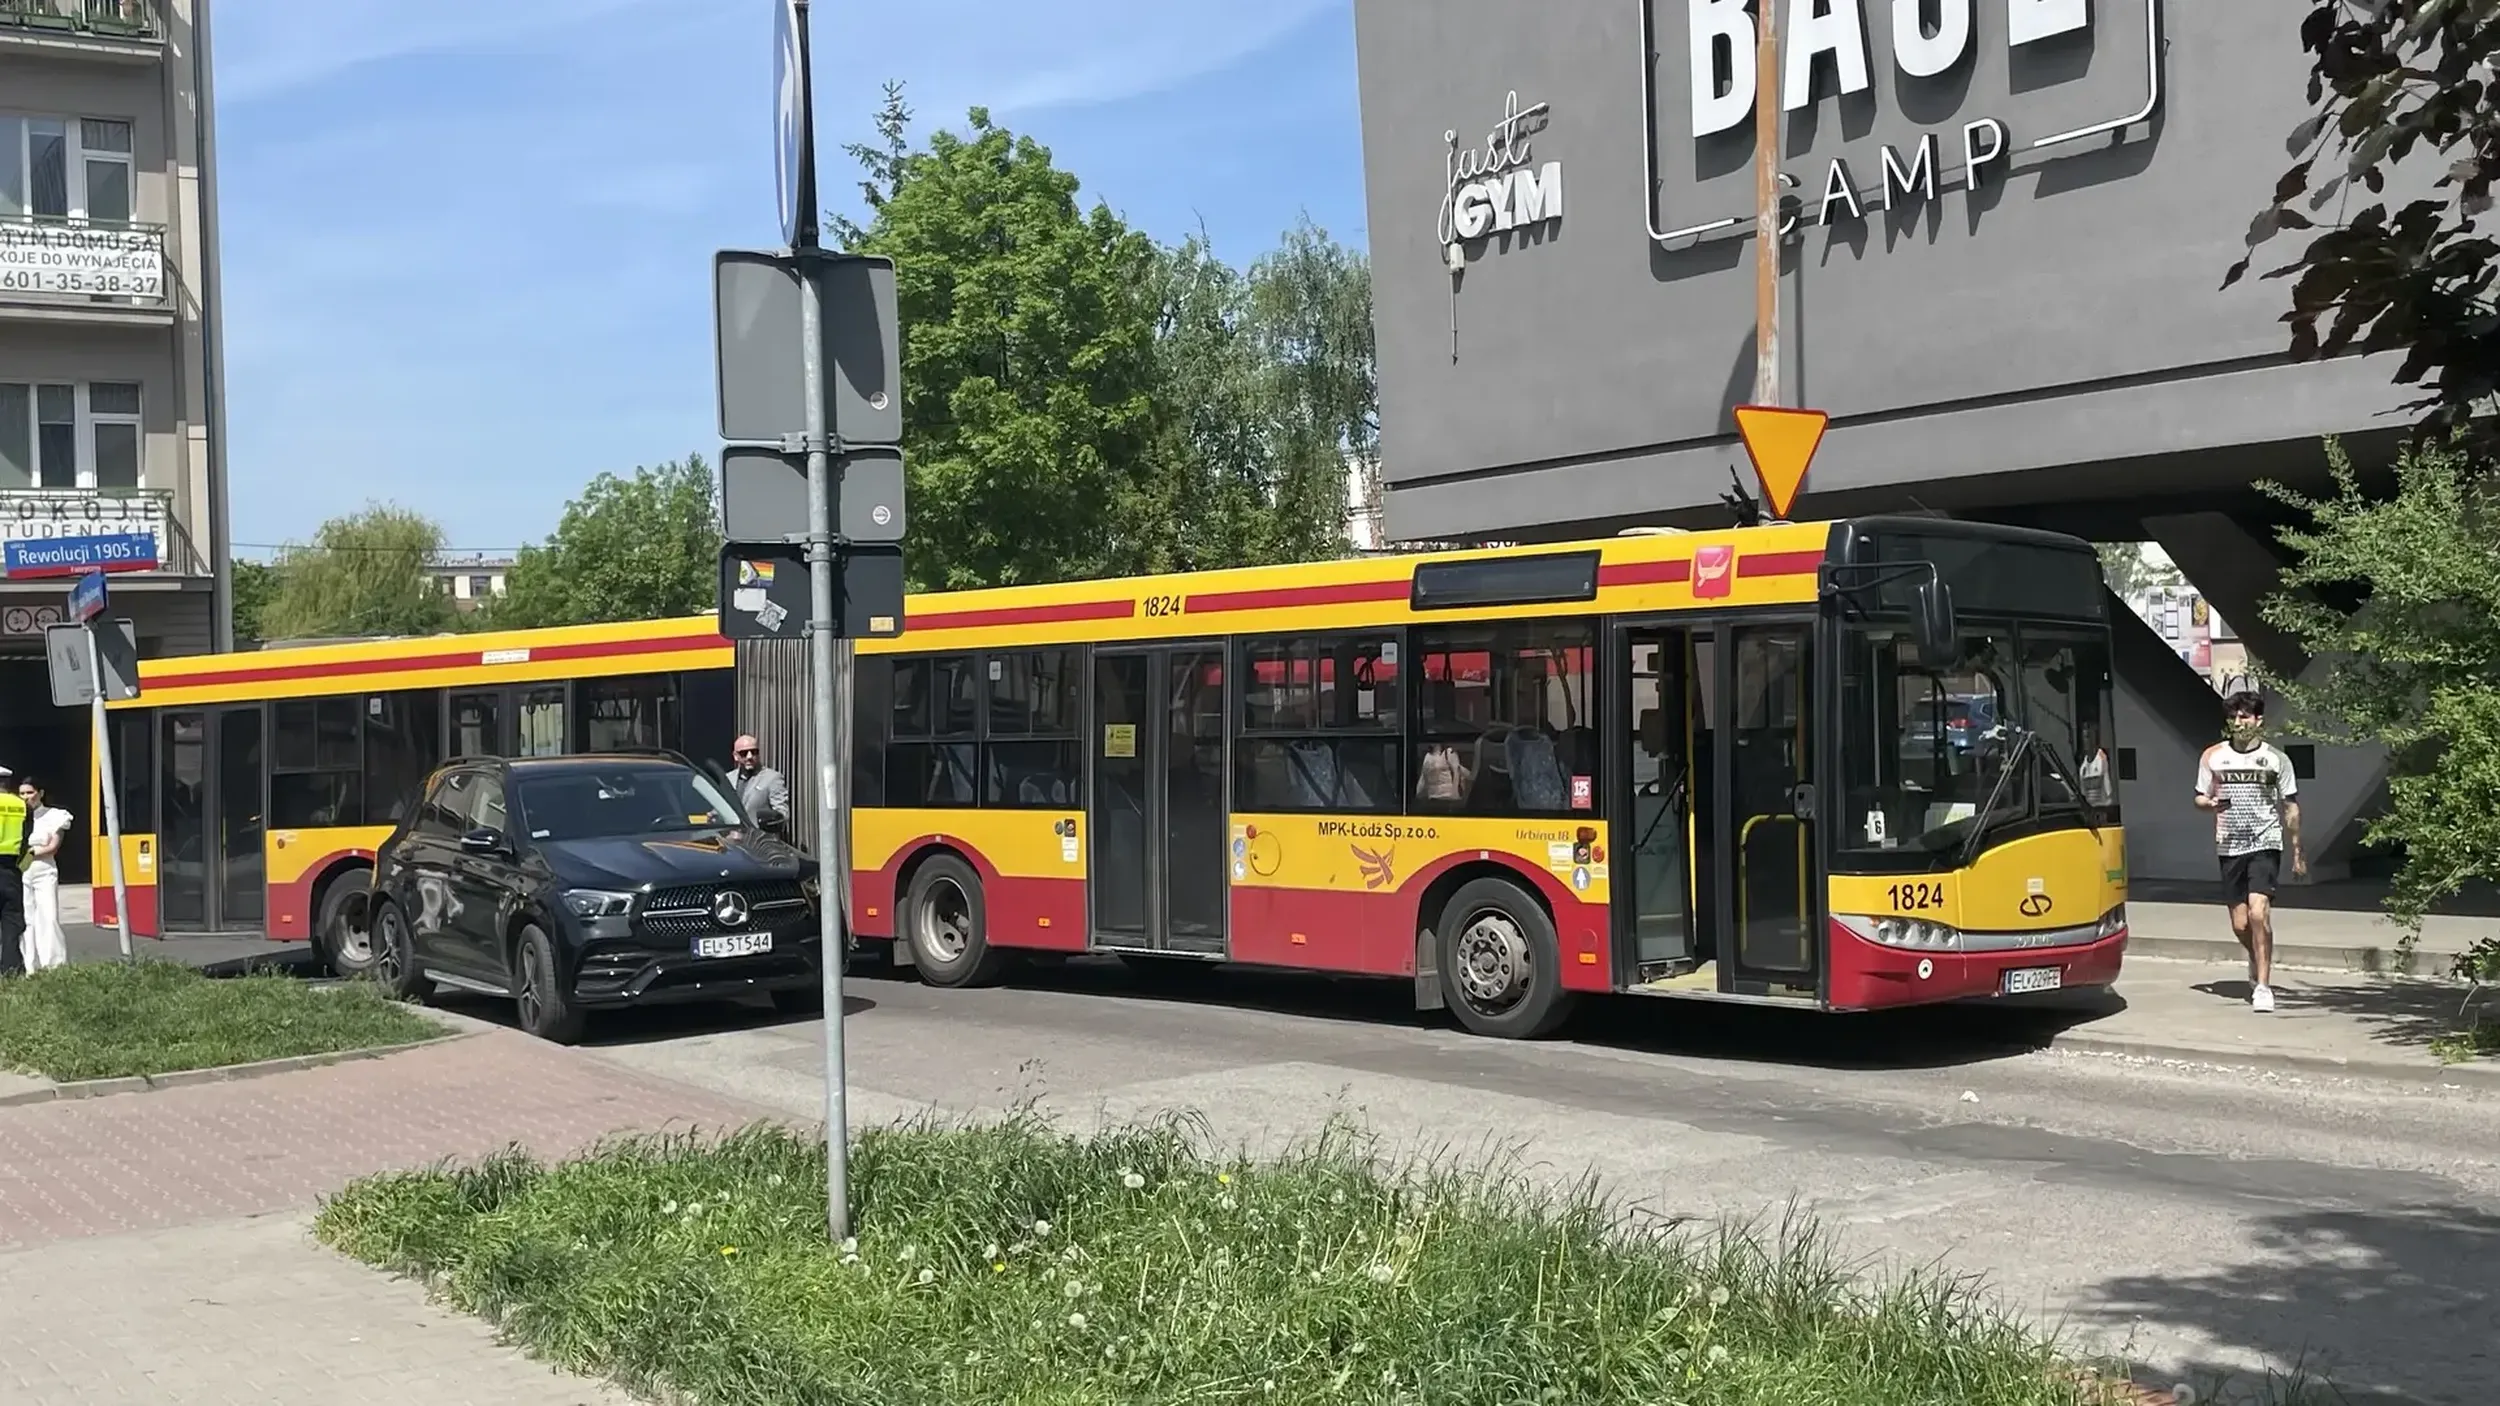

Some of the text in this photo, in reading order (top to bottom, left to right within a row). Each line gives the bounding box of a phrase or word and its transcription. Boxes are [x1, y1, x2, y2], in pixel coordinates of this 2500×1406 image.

[1454, 161, 1562, 239] GYM
[2, 228, 48, 247] TYM
[57, 232, 120, 250] DOMU
[41, 252, 62, 265] DO
[3, 270, 158, 293] 601-35-38-37
[0, 500, 159, 521] OKOJE
[18, 542, 146, 565] Rewolucji 1905 r.
[1143, 595, 1181, 617] 1824
[1888, 882, 1944, 911] 1824
